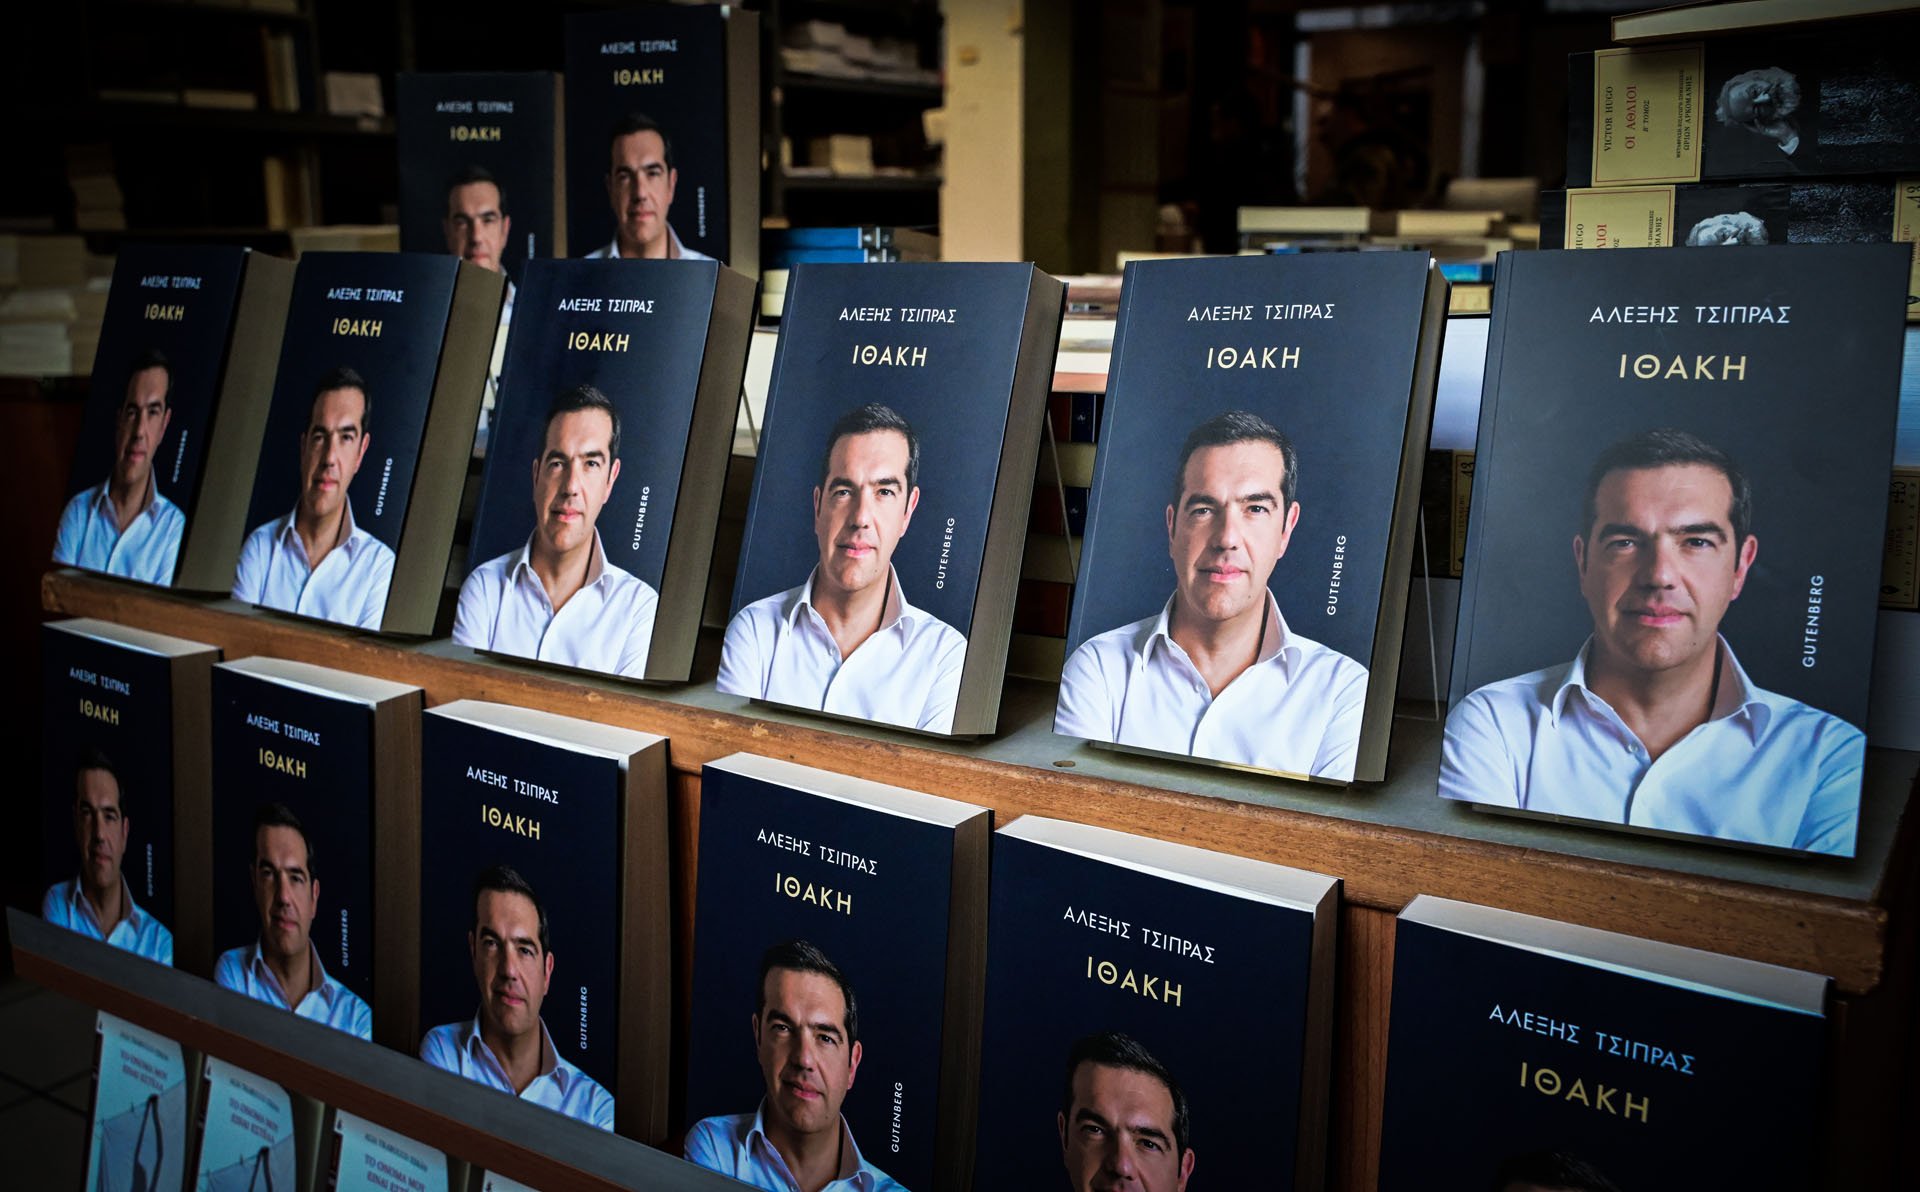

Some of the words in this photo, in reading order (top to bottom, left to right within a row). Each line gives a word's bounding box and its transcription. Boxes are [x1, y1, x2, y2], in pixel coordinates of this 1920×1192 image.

[600, 41, 636, 55] ΑΛΕΞΗΣ
[639, 39, 677, 53] ΤΣΙΠΡΑΣ
[613, 69, 664, 86] ΙΘΑΚΗ
[436, 101, 473, 113] ΑΛΕΞΗΣ
[477, 101, 514, 114] ΤΣΙΠΡΑΣ
[1605, 87, 1614, 113] HUGO
[1625, 85, 1637, 130] ΑΘΛΙΟΙ
[450, 125, 501, 142] ΙΘΑΚΗ
[1604, 118, 1613, 151] VICTOR
[1625, 136, 1636, 149] ΟΙ
[140, 275, 170, 289] ΑΛΕΞΗΣ
[171, 276, 202, 290] ΤΣΙΠΡΑΣ
[327, 287, 363, 301] ΑΛΕΞΗΣ
[366, 288, 404, 303] ΤΣΙΠΡΑΣ
[144, 303, 185, 321] ΙΘΑΚΗ
[558, 298, 603, 312] ΑΛΕΞΗΣ
[608, 299, 655, 314] ΤΣΙΠΡΑΣ
[838, 307, 893, 322] ΑΛΕΞΗΣ
[900, 308, 957, 323] ΤΣΙΠΡΑΣ
[1187, 305, 1254, 322] ΑΛΕΞΗΣ
[1264, 303, 1335, 320] ΤΣΙΠΡΑΣ
[1589, 306, 1680, 324] ΑΛΕΞΗΣ
[1695, 306, 1791, 324] ΤΣΙΠΡΑΣ
[332, 317, 383, 338] ΙΘΑΚΗ
[568, 331, 630, 353] ΙΘΑΚΗ
[852, 344, 928, 367] ΙΘΑΚΗ
[1207, 346, 1301, 369] ΙΘΑΚΗ
[1619, 353, 1747, 381] ΙΘΑΚΗ
[375, 457, 393, 516] GUTENBERG
[632, 486, 650, 551] GUTENBERG
[935, 517, 956, 590] GUTENBERG
[1326, 535, 1347, 616] GUTENBERG
[1802, 575, 1824, 668] GUTENBERG
[69, 667, 98, 686] ΑΛΕΞΗΣ
[100, 675, 131, 696] ΤΣΙΠΡΑΣ
[79, 698, 120, 726] ΙΘΑΚΗ
[246, 713, 280, 734] ΑΛΕΞΗΣ
[283, 723, 321, 746] ΤΣΙΠΡΑΣ
[259, 747, 307, 779] ΙΘΑΚΗ
[466, 765, 508, 790] ΑΛΕΞΗΣ
[513, 778, 559, 805] ΤΣΙΠΡΑΣ
[482, 804, 541, 841] ΙΘΑΚΗ
[756, 828, 811, 857] ΑΛΕΞΗΣ
[819, 845, 878, 876] ΤΣΙΠΡΑΣ
[775, 872, 852, 915] ΙΘΑΚΗ
[340, 908, 349, 967] GUTENBERG
[1063, 906, 1131, 940] ΑΛΕΞΗΣ
[1141, 927, 1215, 964] ΤΣΙΠΡΑΣ
[1087, 955, 1182, 1007] ΙΘΑΚΗ
[580, 986, 588, 1050] GUTENBERG
[1488, 1004, 1580, 1044] ΑΛΕΞΗΣ
[1595, 1031, 1695, 1075] ΤΣΙΠΡΑΣ
[1520, 1061, 1649, 1123] ΙΘΑΚΗ
[891, 1082, 903, 1153] GUTENBERG
